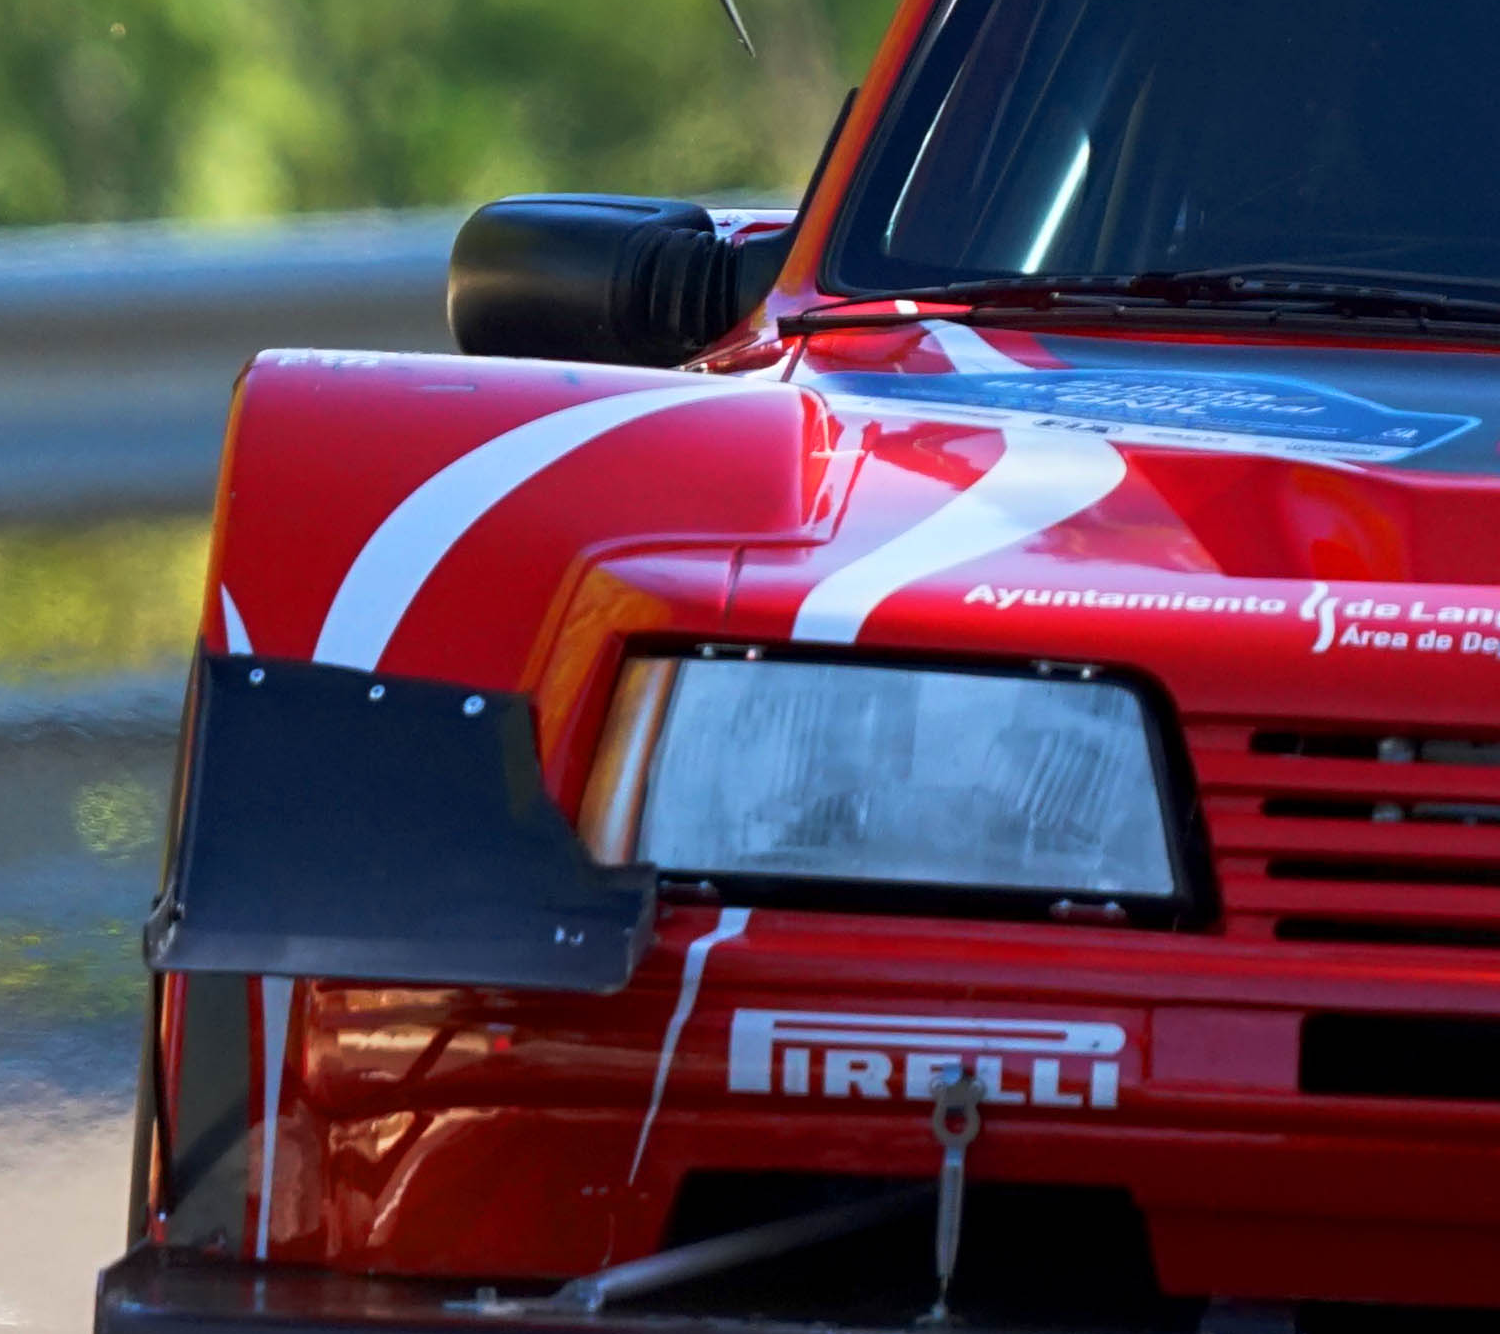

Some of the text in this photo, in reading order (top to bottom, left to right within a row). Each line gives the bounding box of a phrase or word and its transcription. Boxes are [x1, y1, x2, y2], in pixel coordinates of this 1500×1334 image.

[963, 584, 1287, 610] Ayuntamiento
[1343, 598, 1401, 619] de
[1339, 621, 1409, 649] Área
[1416, 628, 1453, 651] de
[728, 1007, 1127, 1111] PIRELLI
